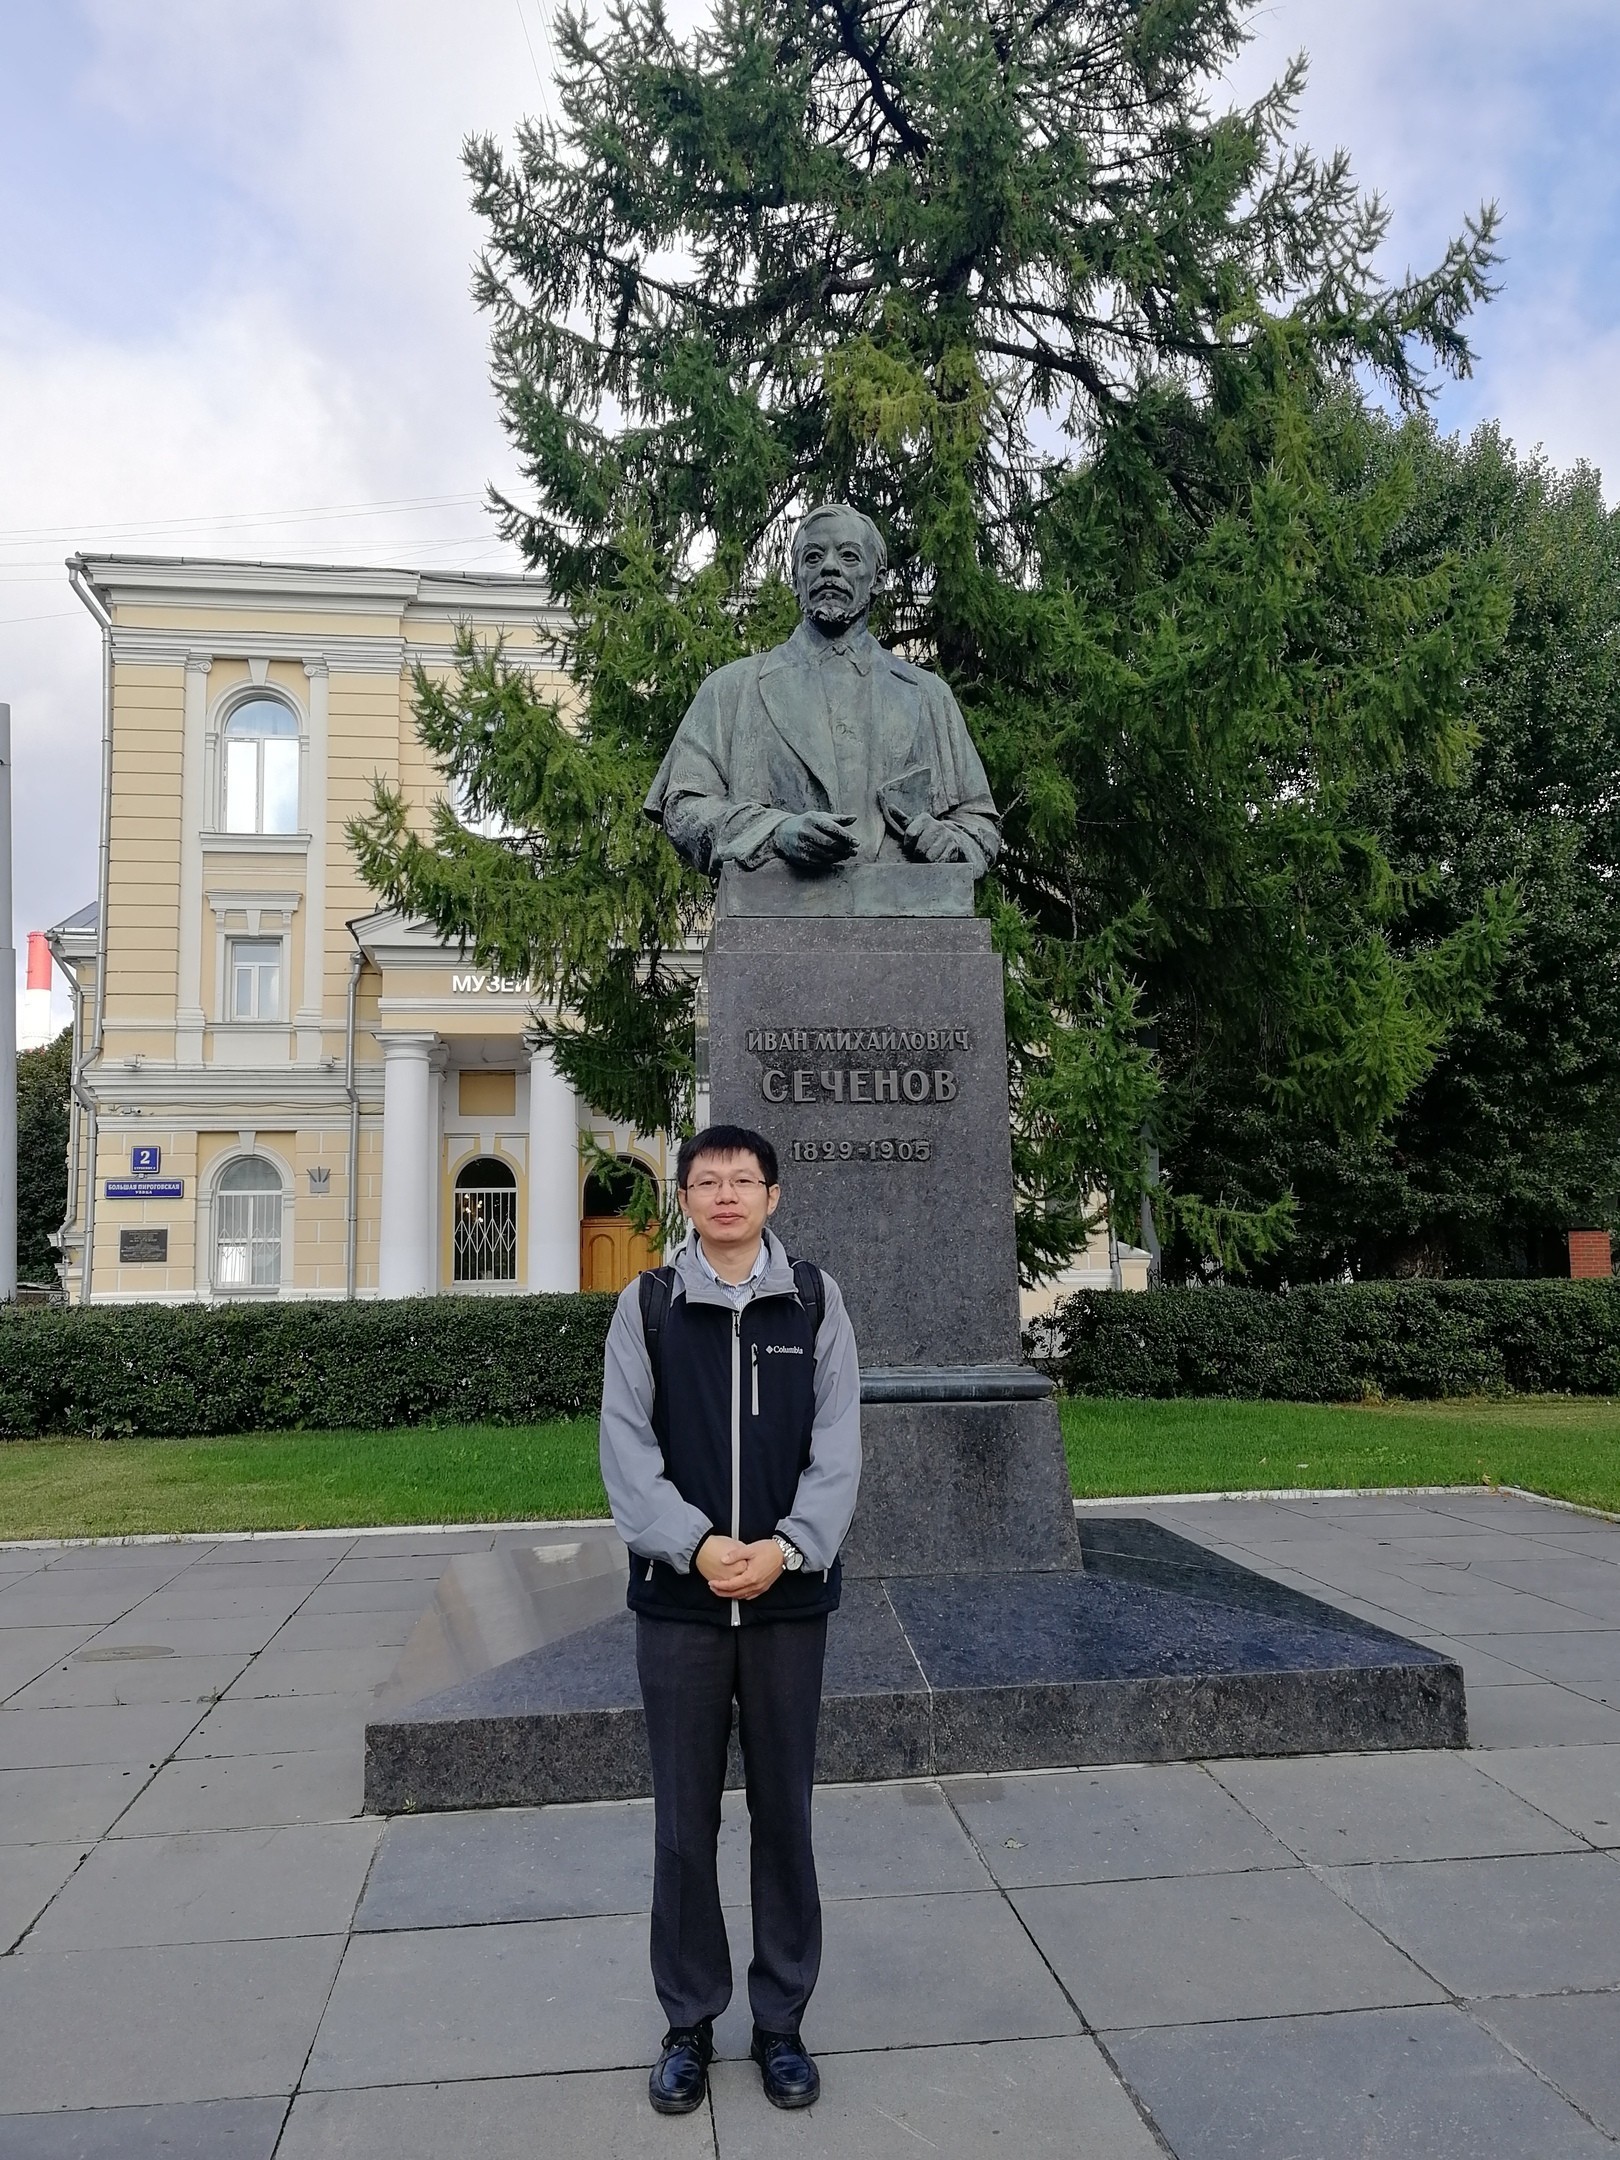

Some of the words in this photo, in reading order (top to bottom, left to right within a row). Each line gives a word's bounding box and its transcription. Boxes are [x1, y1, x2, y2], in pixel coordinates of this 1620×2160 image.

[748, 1032, 807, 1051] ИВАН
[762, 1070, 957, 1102] СЕЧЕНОВ
[140, 1151, 150, 1164] 2
[794, 1141, 932, 1161] 1829-1905
[774, 1346, 804, 1354] Columbia
